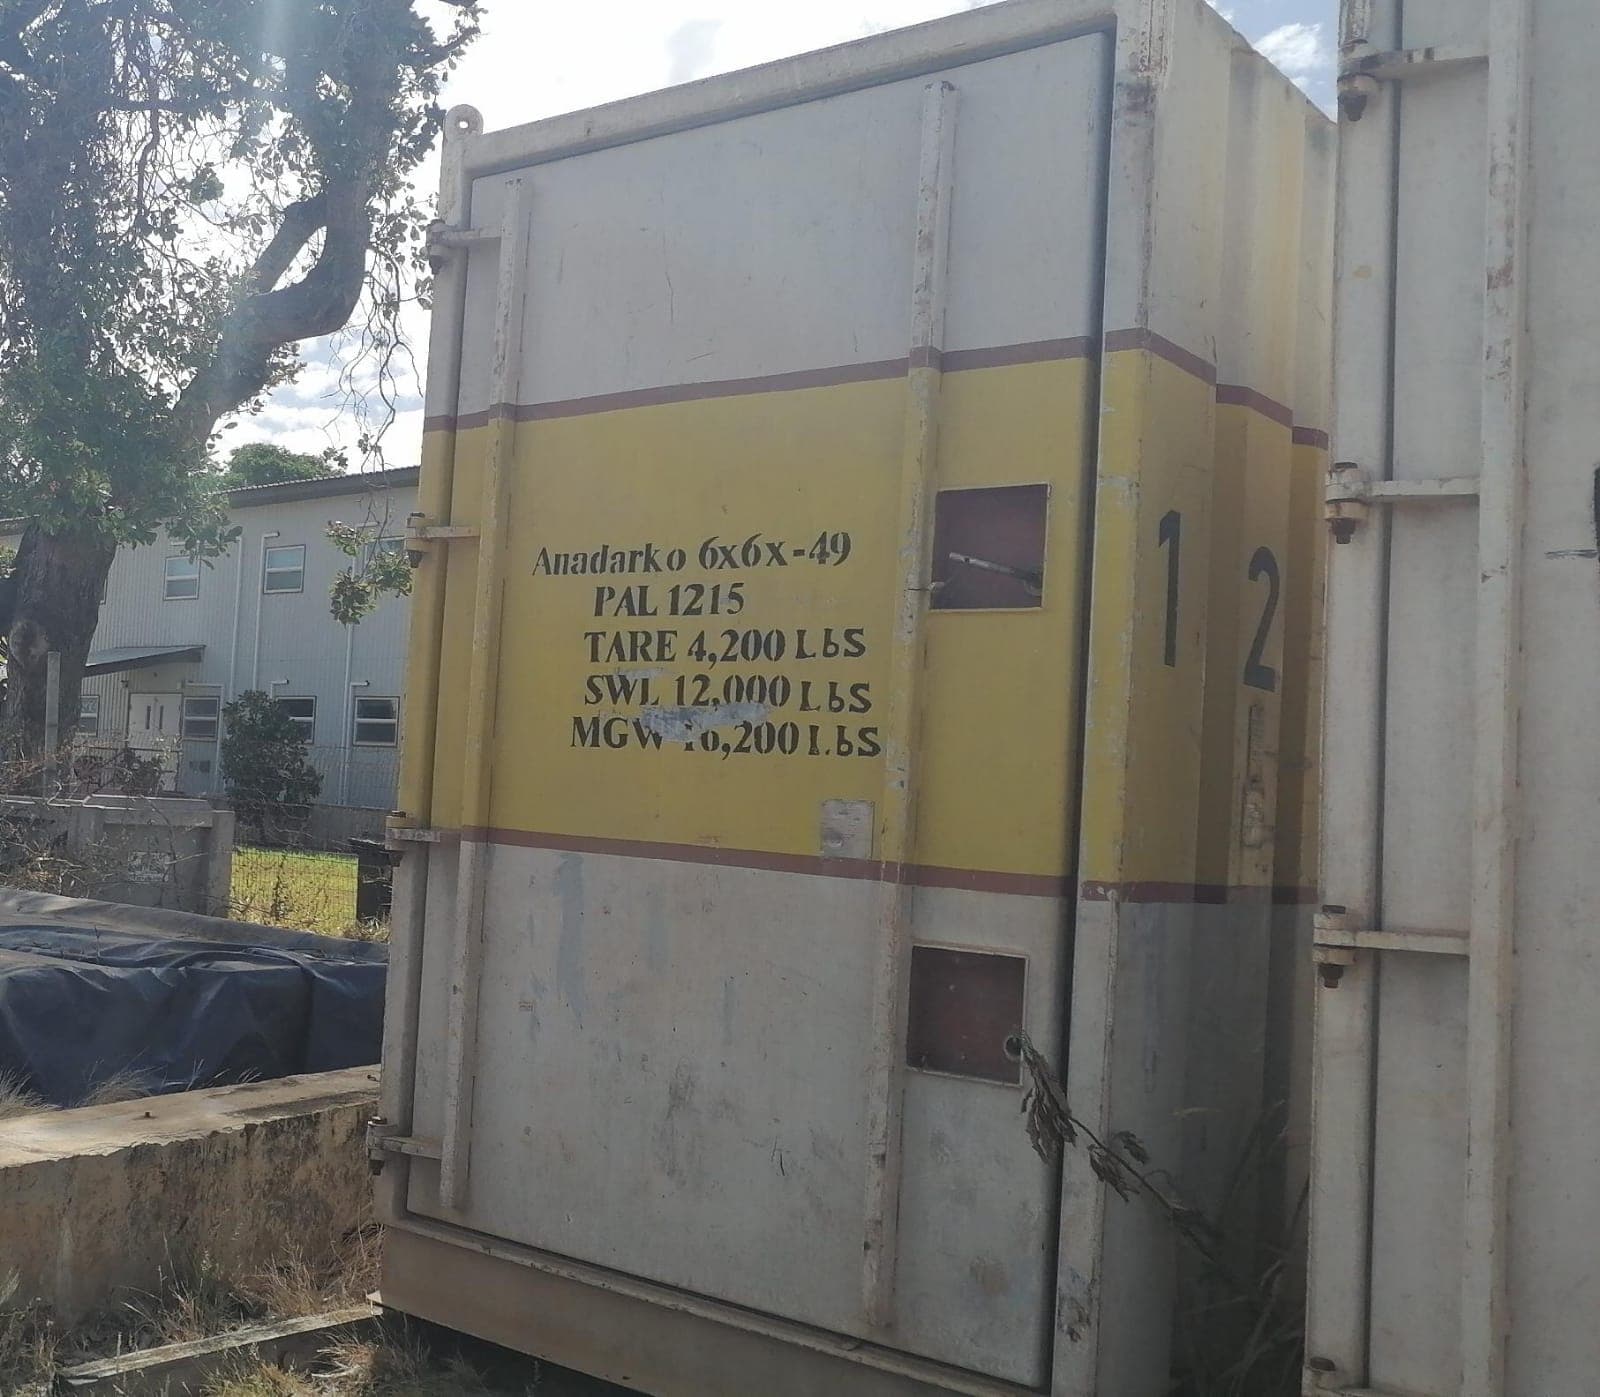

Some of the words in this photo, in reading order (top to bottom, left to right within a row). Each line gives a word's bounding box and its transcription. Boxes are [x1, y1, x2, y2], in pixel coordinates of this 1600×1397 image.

[532, 542, 687, 576] Anadarko
[698, 530, 851, 570] 6x6x-49
[594, 585, 658, 617] PAL
[667, 582, 745, 616] 1215
[583, 629, 678, 663] TARE
[687, 628, 786, 670] 4,200
[584, 674, 660, 706] SWL
[675, 673, 791, 711] 12,000
